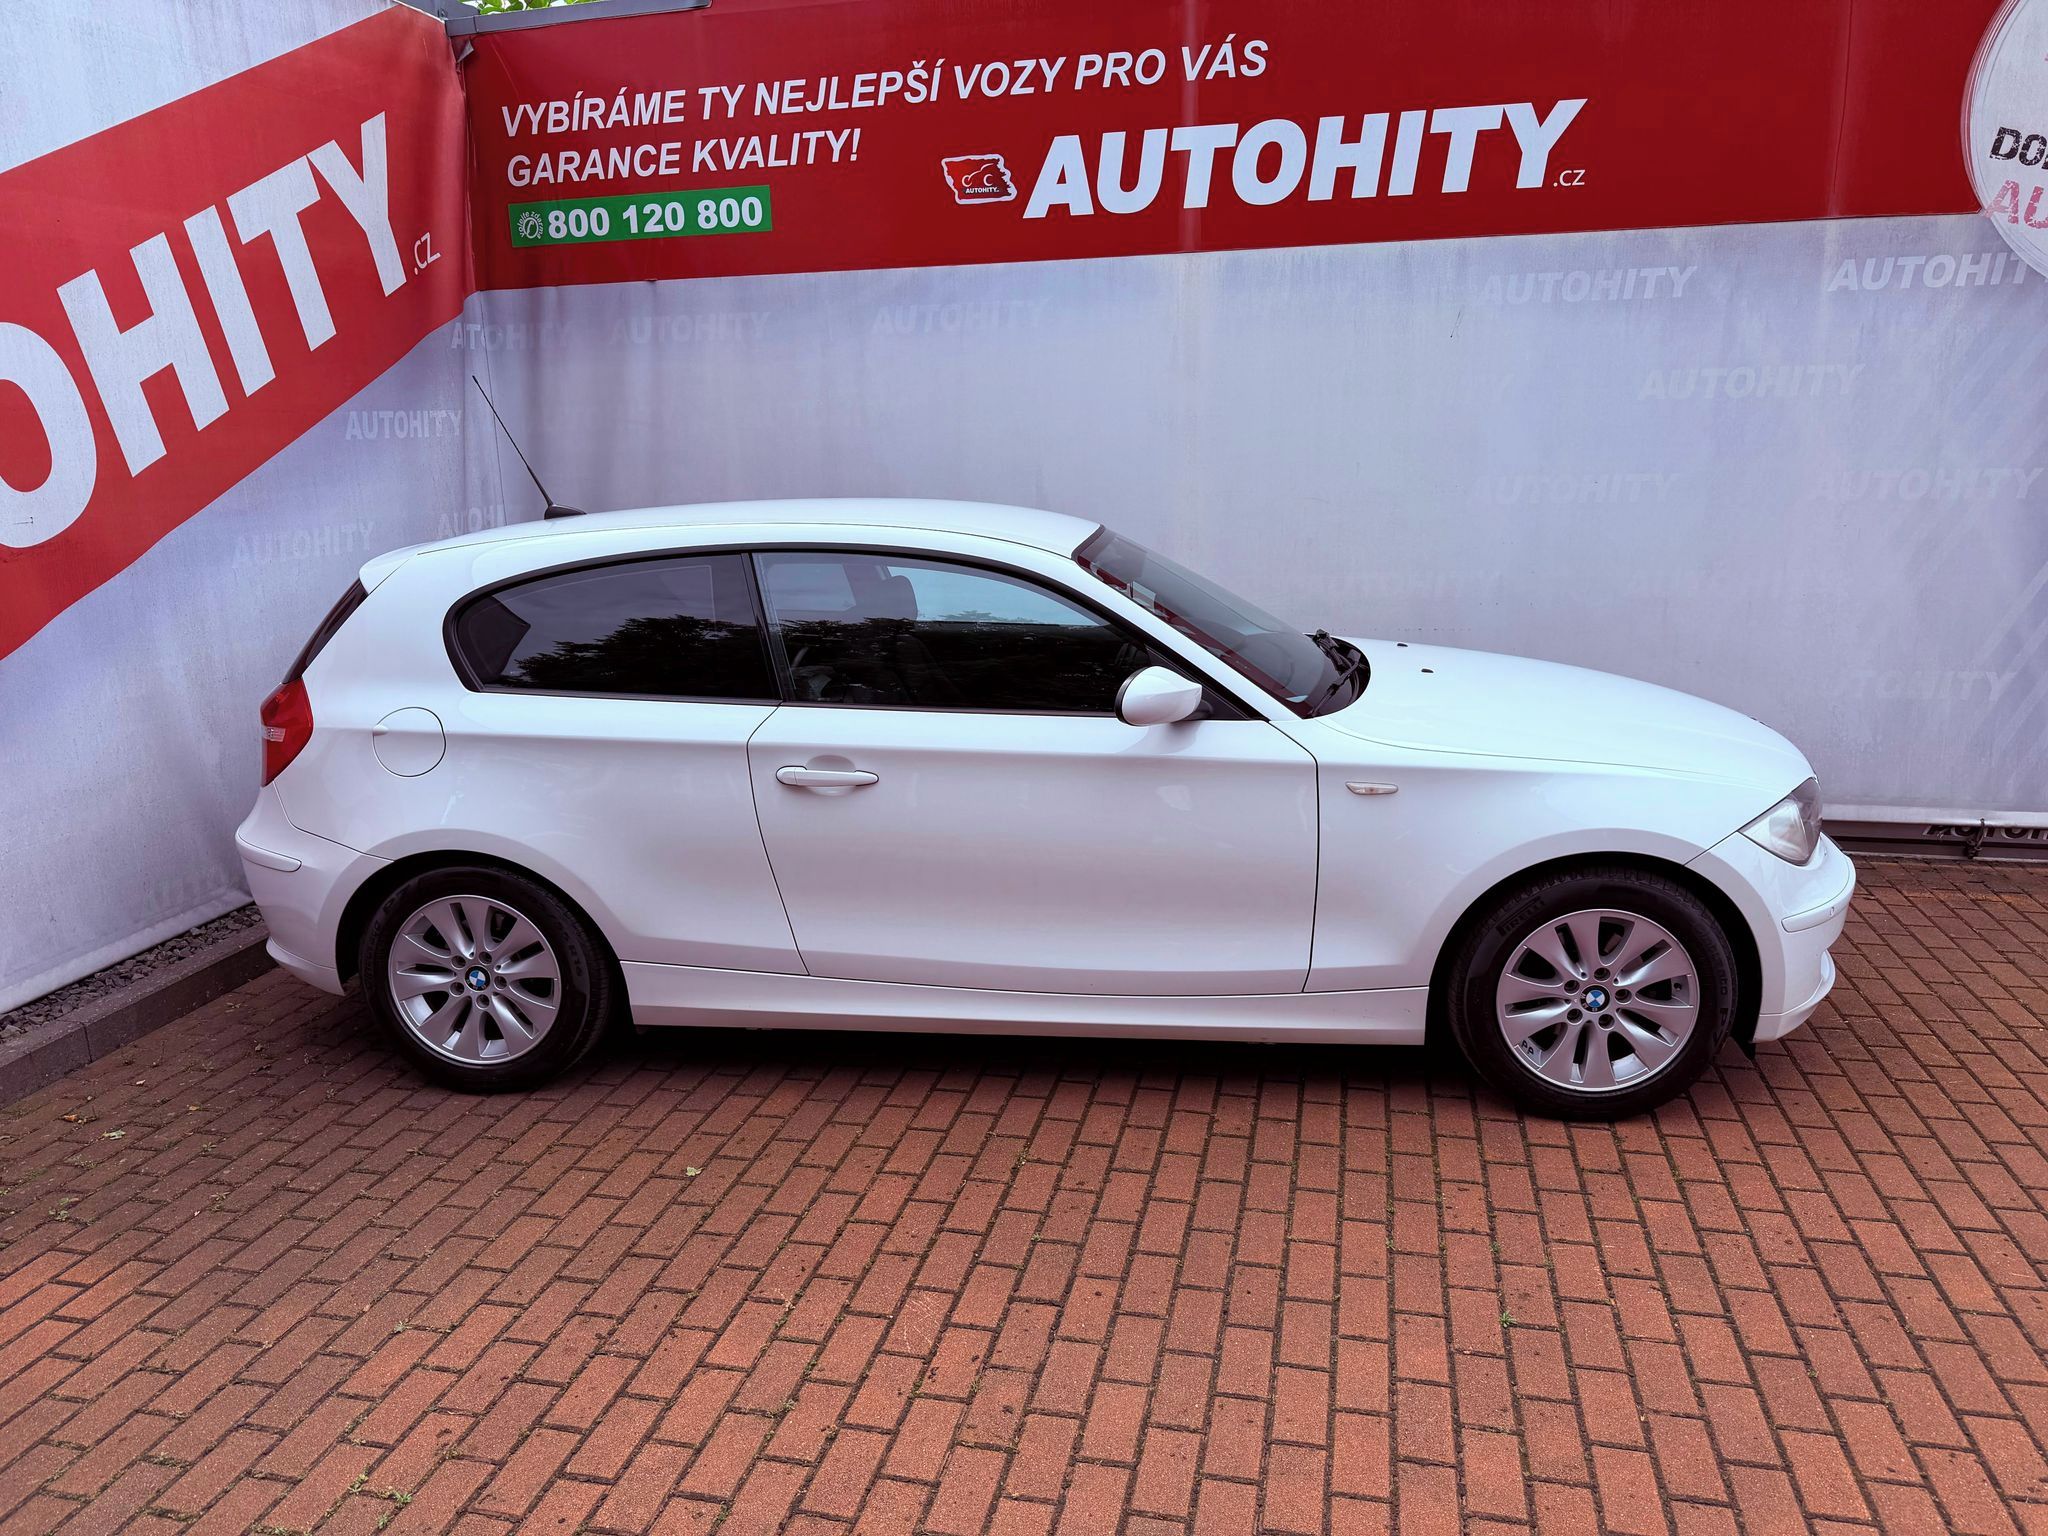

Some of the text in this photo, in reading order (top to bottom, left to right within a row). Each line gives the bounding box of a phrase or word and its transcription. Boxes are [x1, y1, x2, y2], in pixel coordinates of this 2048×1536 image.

[501, 33, 1270, 138] VYBÍRÁME TY NEJLEPŠÍ VOZY PRO VÁS
[507, 128, 862, 188] GARANCE KVALITY!
[548, 196, 763, 239] 800 120 800
[1477, 265, 1698, 305] AUTOHITY
[608, 311, 771, 345] AUTOHITY
[1637, 362, 1866, 402] AUTOHITY
[345, 409, 462, 441] AUTOHITY
[1467, 471, 1682, 505] AUTOHITY
[1806, 466, 2044, 503] AUTOHITY
[231, 520, 376, 569] AUTOHITY
